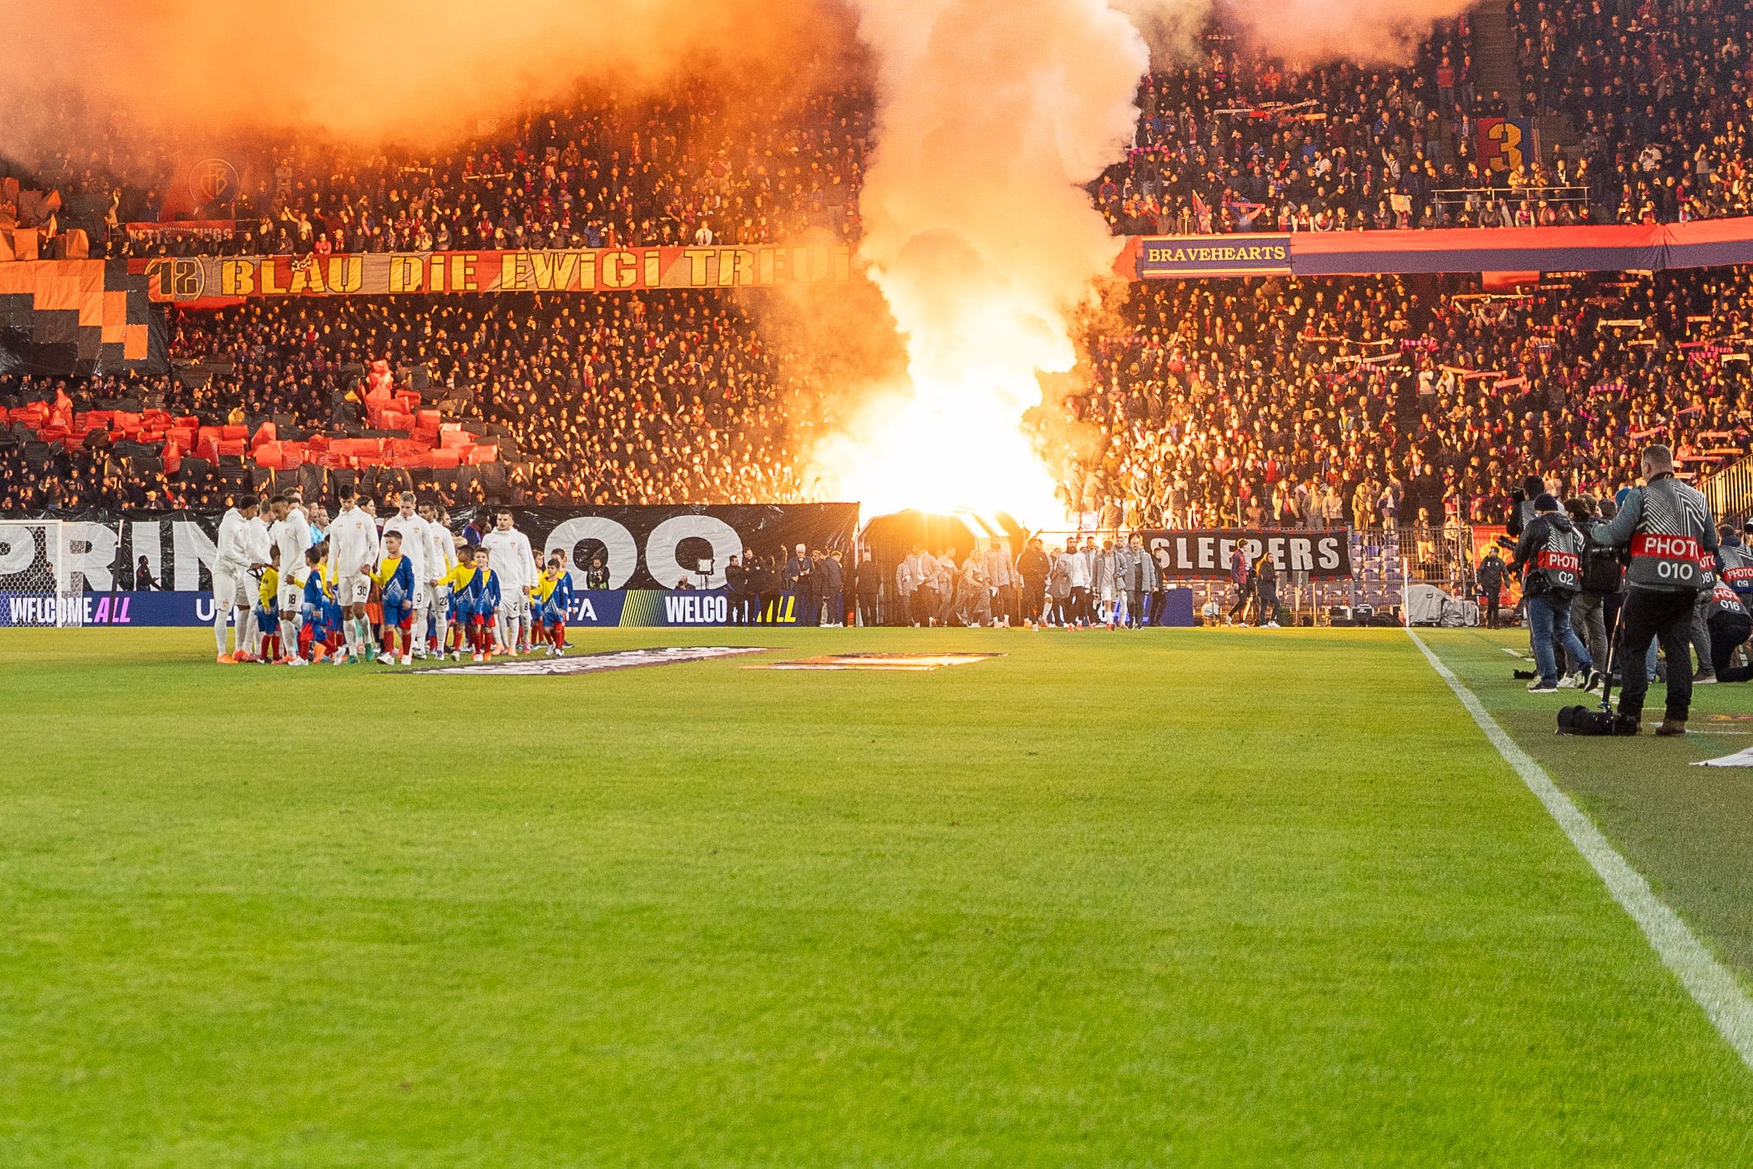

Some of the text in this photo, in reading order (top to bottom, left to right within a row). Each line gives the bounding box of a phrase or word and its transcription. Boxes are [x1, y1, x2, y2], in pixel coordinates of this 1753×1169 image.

[1488, 122, 1522, 171] 3
[1148, 246, 1286, 262] BRAVEHEARTS
[220, 256, 364, 296] BLAU
[1149, 537, 1340, 570] SLEEPERS
[1644, 537, 1699, 560] PHOT
[1549, 554, 1578, 570] PHOT
[1657, 561, 1693, 580] 010
[288, 593, 297, 605] 18
[357, 585, 367, 597] 30
[9, 597, 132, 623] WELCOME ALL
[1720, 599, 1741, 611] 016
